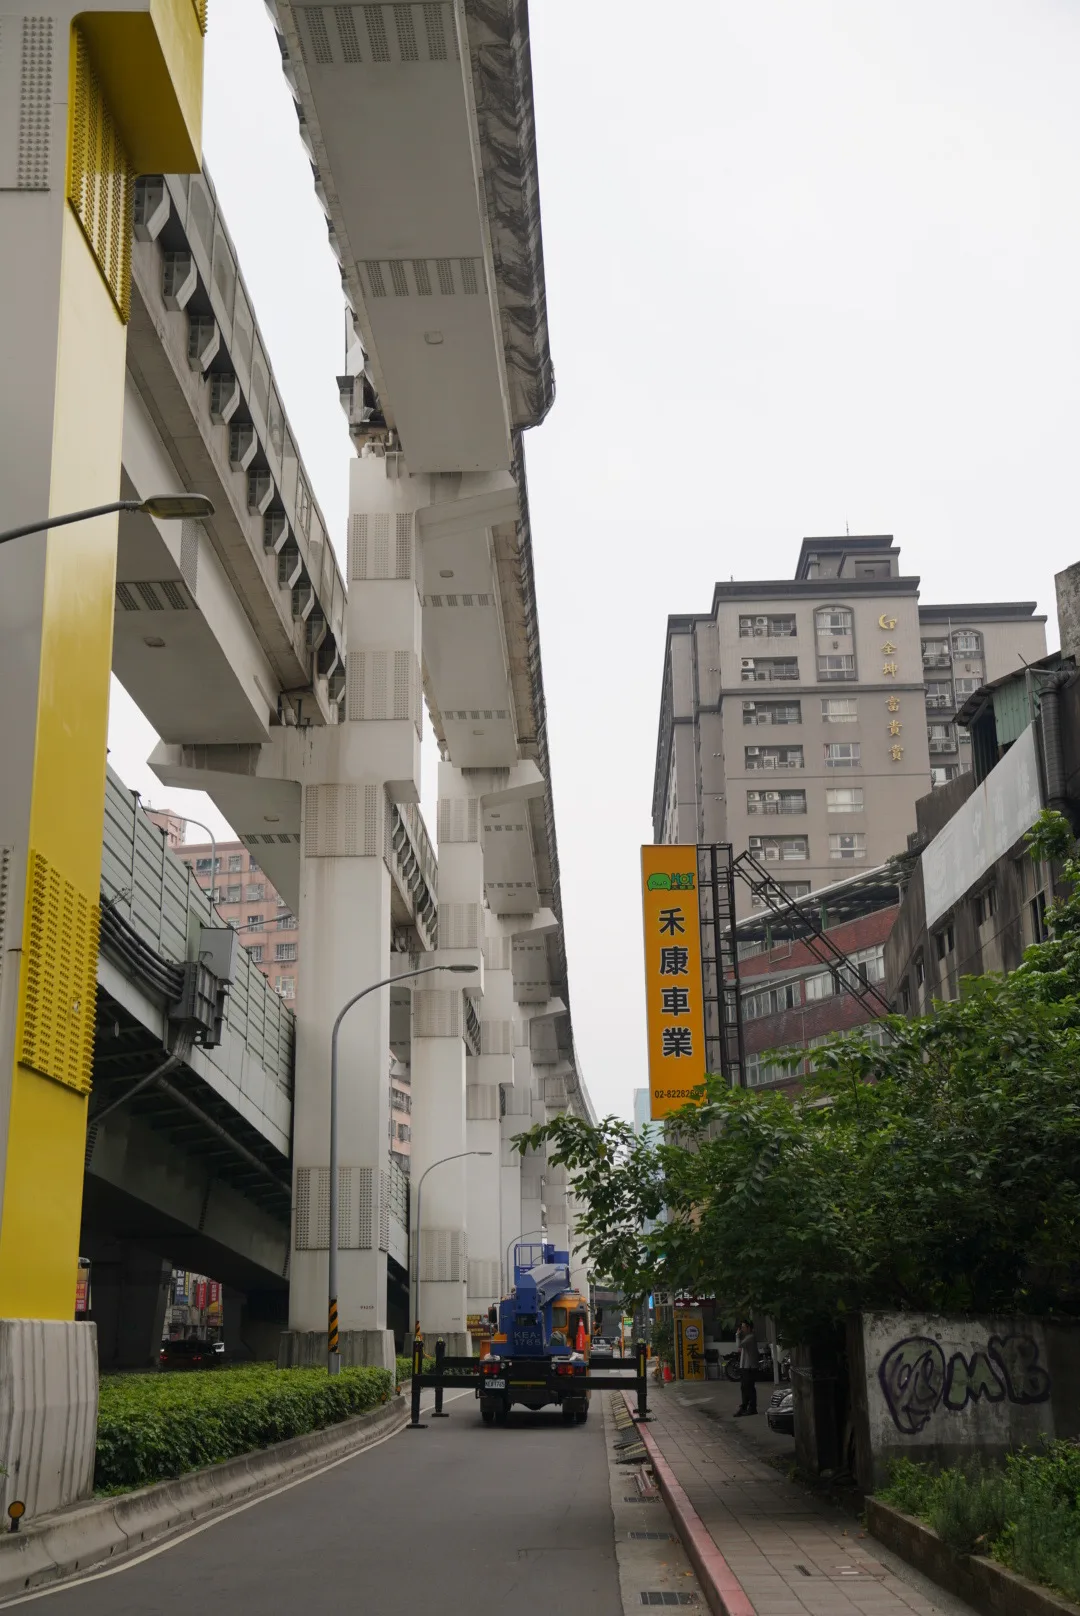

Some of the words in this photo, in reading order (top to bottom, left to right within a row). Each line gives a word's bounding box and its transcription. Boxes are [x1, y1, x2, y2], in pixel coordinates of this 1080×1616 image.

[671, 872, 694, 885] HOT
[658, 907, 693, 1058] 禾康車業
